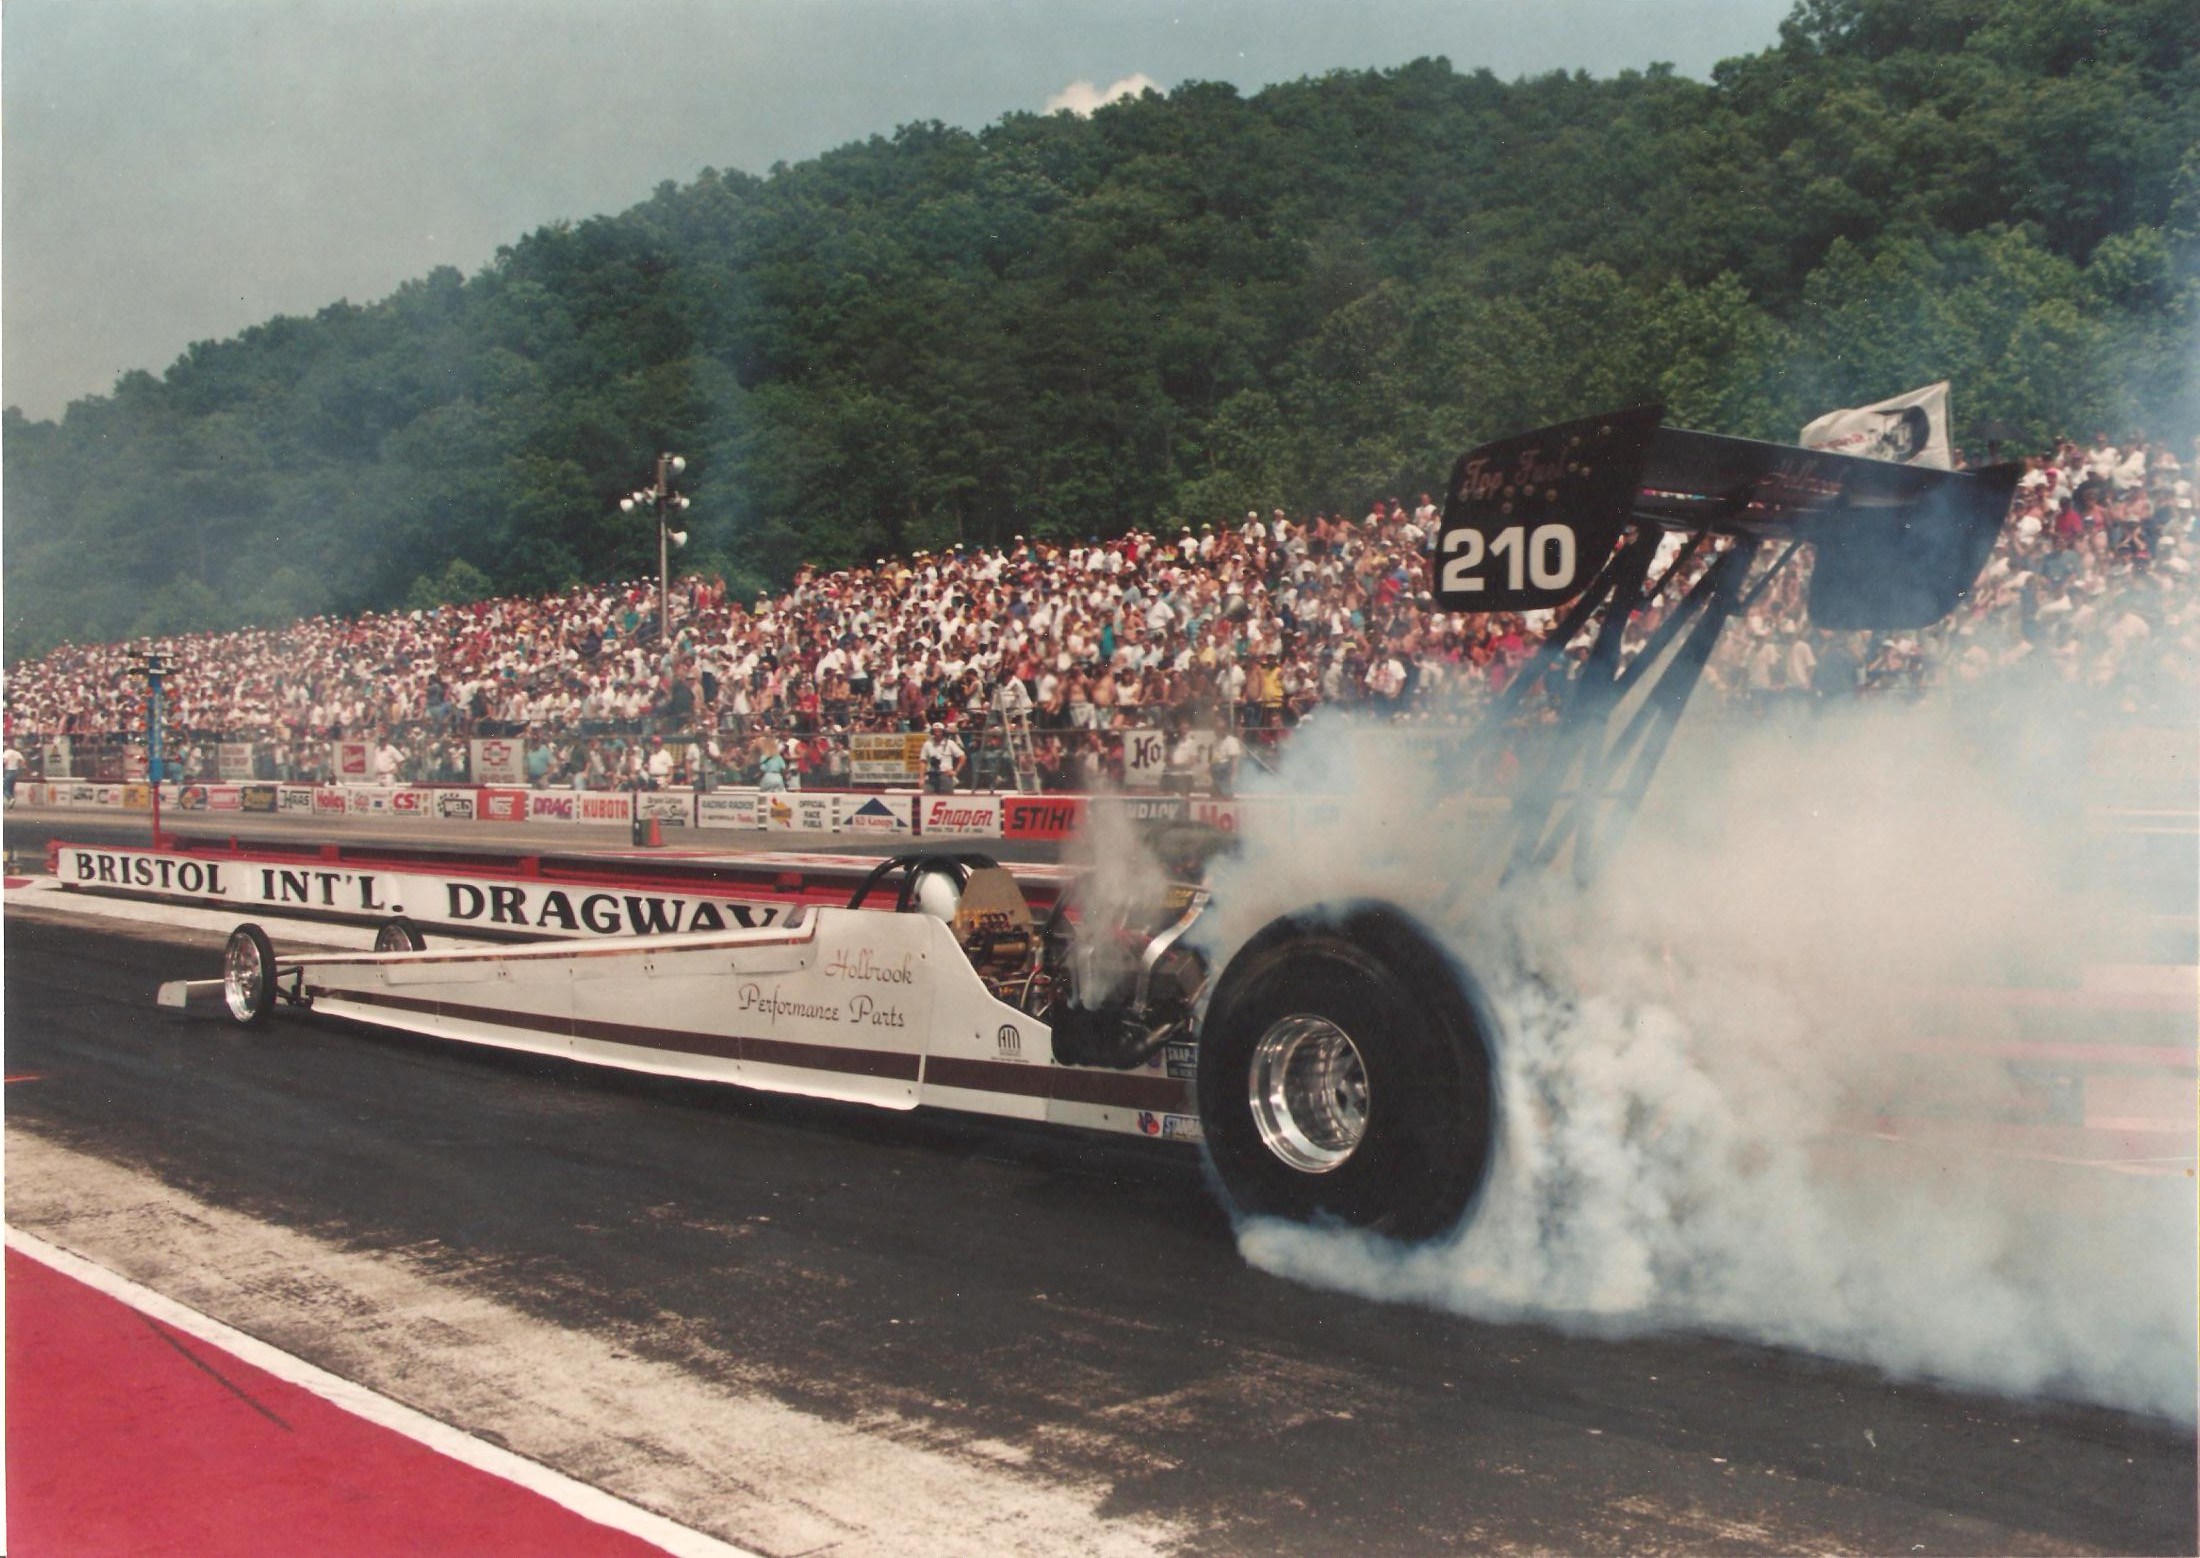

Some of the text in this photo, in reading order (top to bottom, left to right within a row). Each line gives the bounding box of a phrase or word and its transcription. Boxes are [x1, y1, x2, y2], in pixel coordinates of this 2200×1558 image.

[1460, 443, 1570, 500] Top Fuel
[1441, 523, 1577, 592] 210
[533, 797, 573, 817] DRAG
[583, 798, 630, 820] KUBOTA
[799, 800, 826, 809] OFFICIAL
[804, 811, 820, 819] RACE
[803, 820, 822, 828] FUELS
[1011, 806, 1077, 831] STIHL
[76, 853, 779, 936] BRISTOL INT'L. DRAGWAY
[824, 948, 912, 985] Holbrook
[738, 982, 904, 1028] Performance Parts
